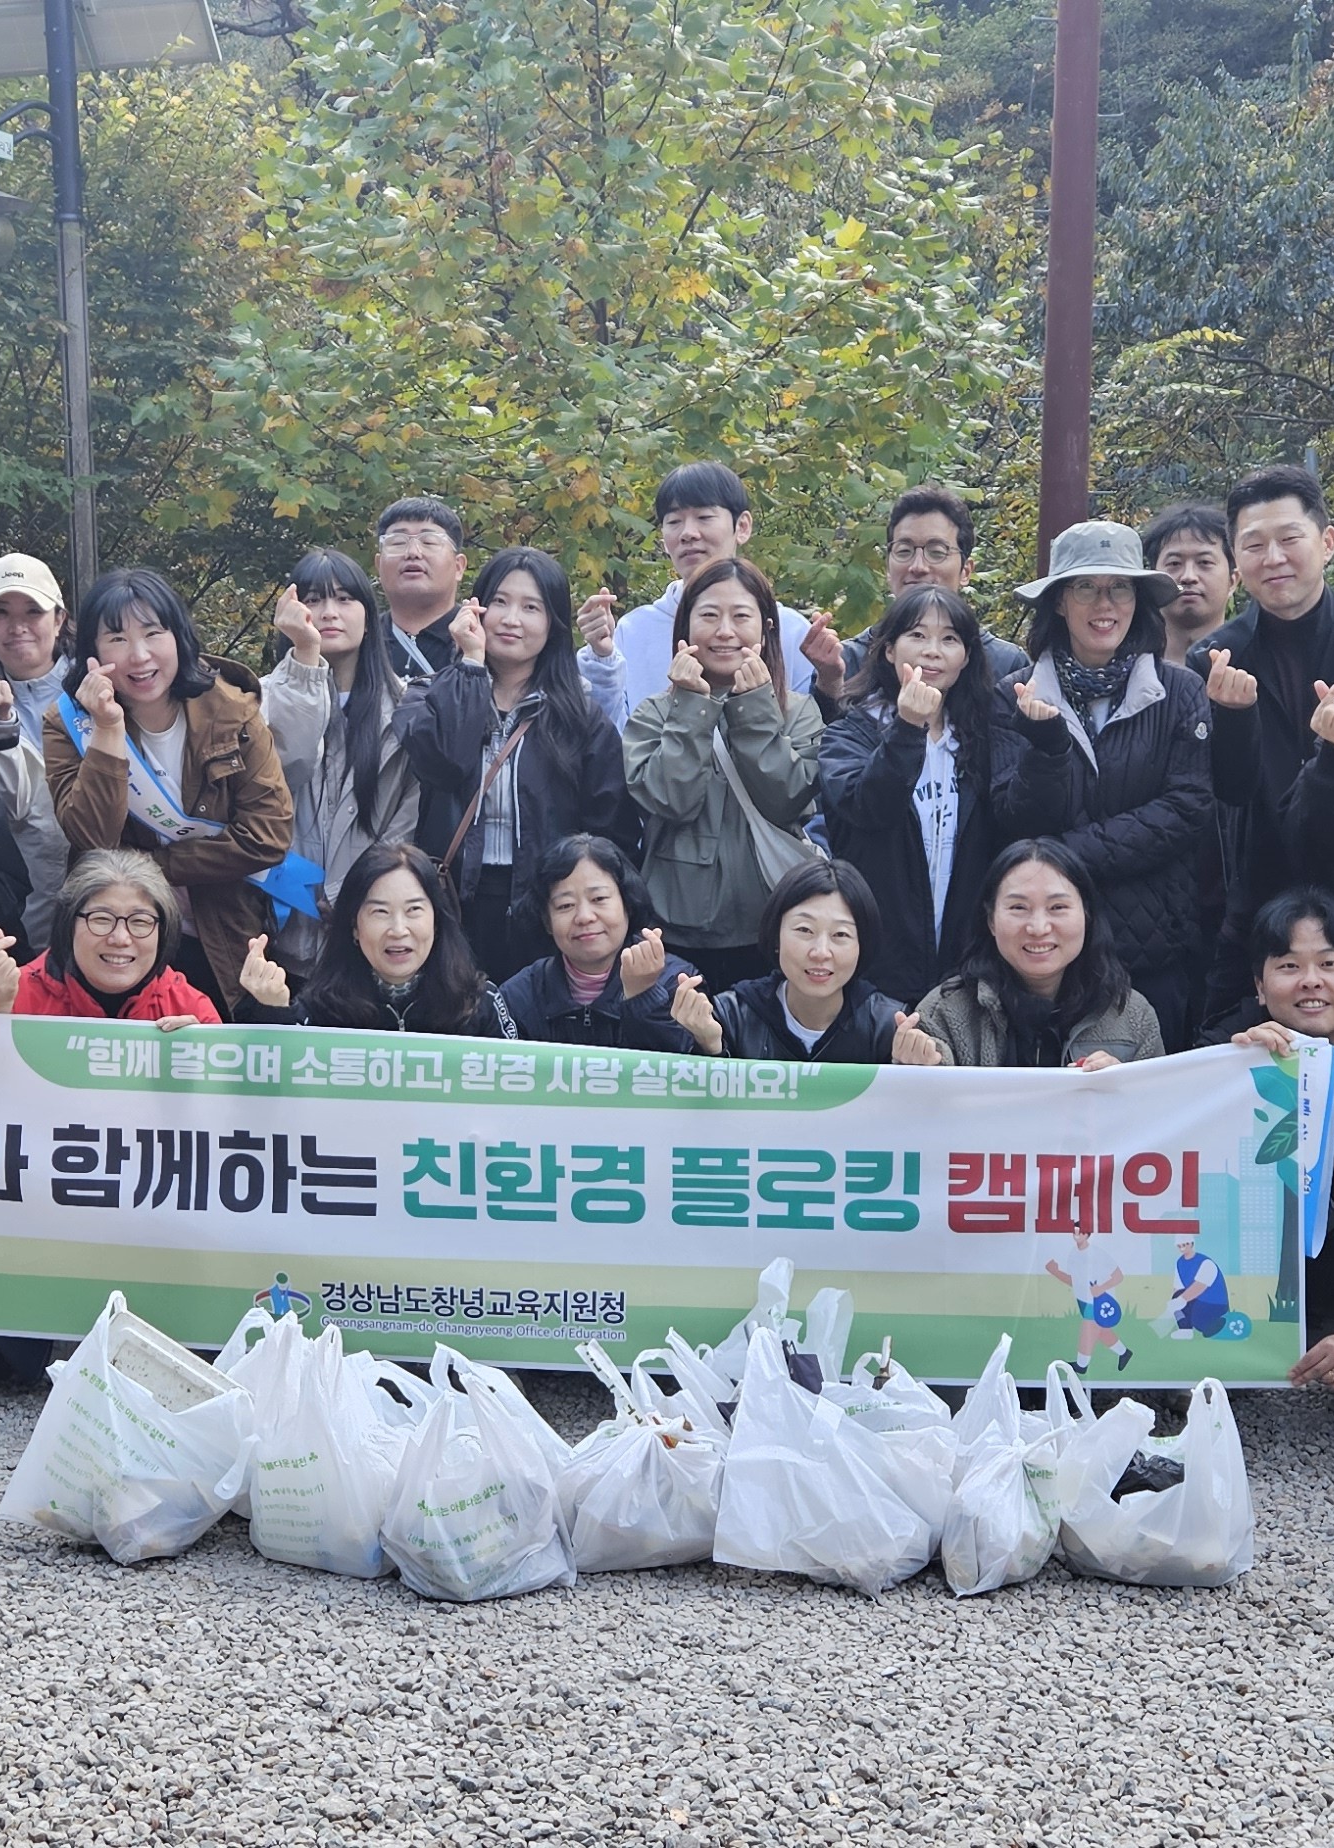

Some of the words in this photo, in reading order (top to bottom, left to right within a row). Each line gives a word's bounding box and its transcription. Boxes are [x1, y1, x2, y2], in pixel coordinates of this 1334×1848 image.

[145, 803, 196, 836] 선택이
[170, 1041, 281, 1083] 걸으며
[291, 1047, 451, 1093] 소통하고,
[460, 1051, 536, 1093] 환경
[546, 1055, 623, 1095] 사랑
[51, 1123, 377, 1217] 함께하는
[402, 1137, 646, 1224] 친환경
[671, 1147, 922, 1232] 플로킹
[947, 1151, 1201, 1234] 캠페인
[321, 1282, 625, 1324] 경상남도창녕교육지원청
[320, 1315, 433, 1333] Gyeongsangnam-do
[436, 1322, 513, 1338] Changnyeong
[516, 1325, 551, 1338] Office
[553, 1326, 567, 1338] of
[568, 1328, 626, 1341] Education
[450, 1493, 483, 1513] 아름다운
